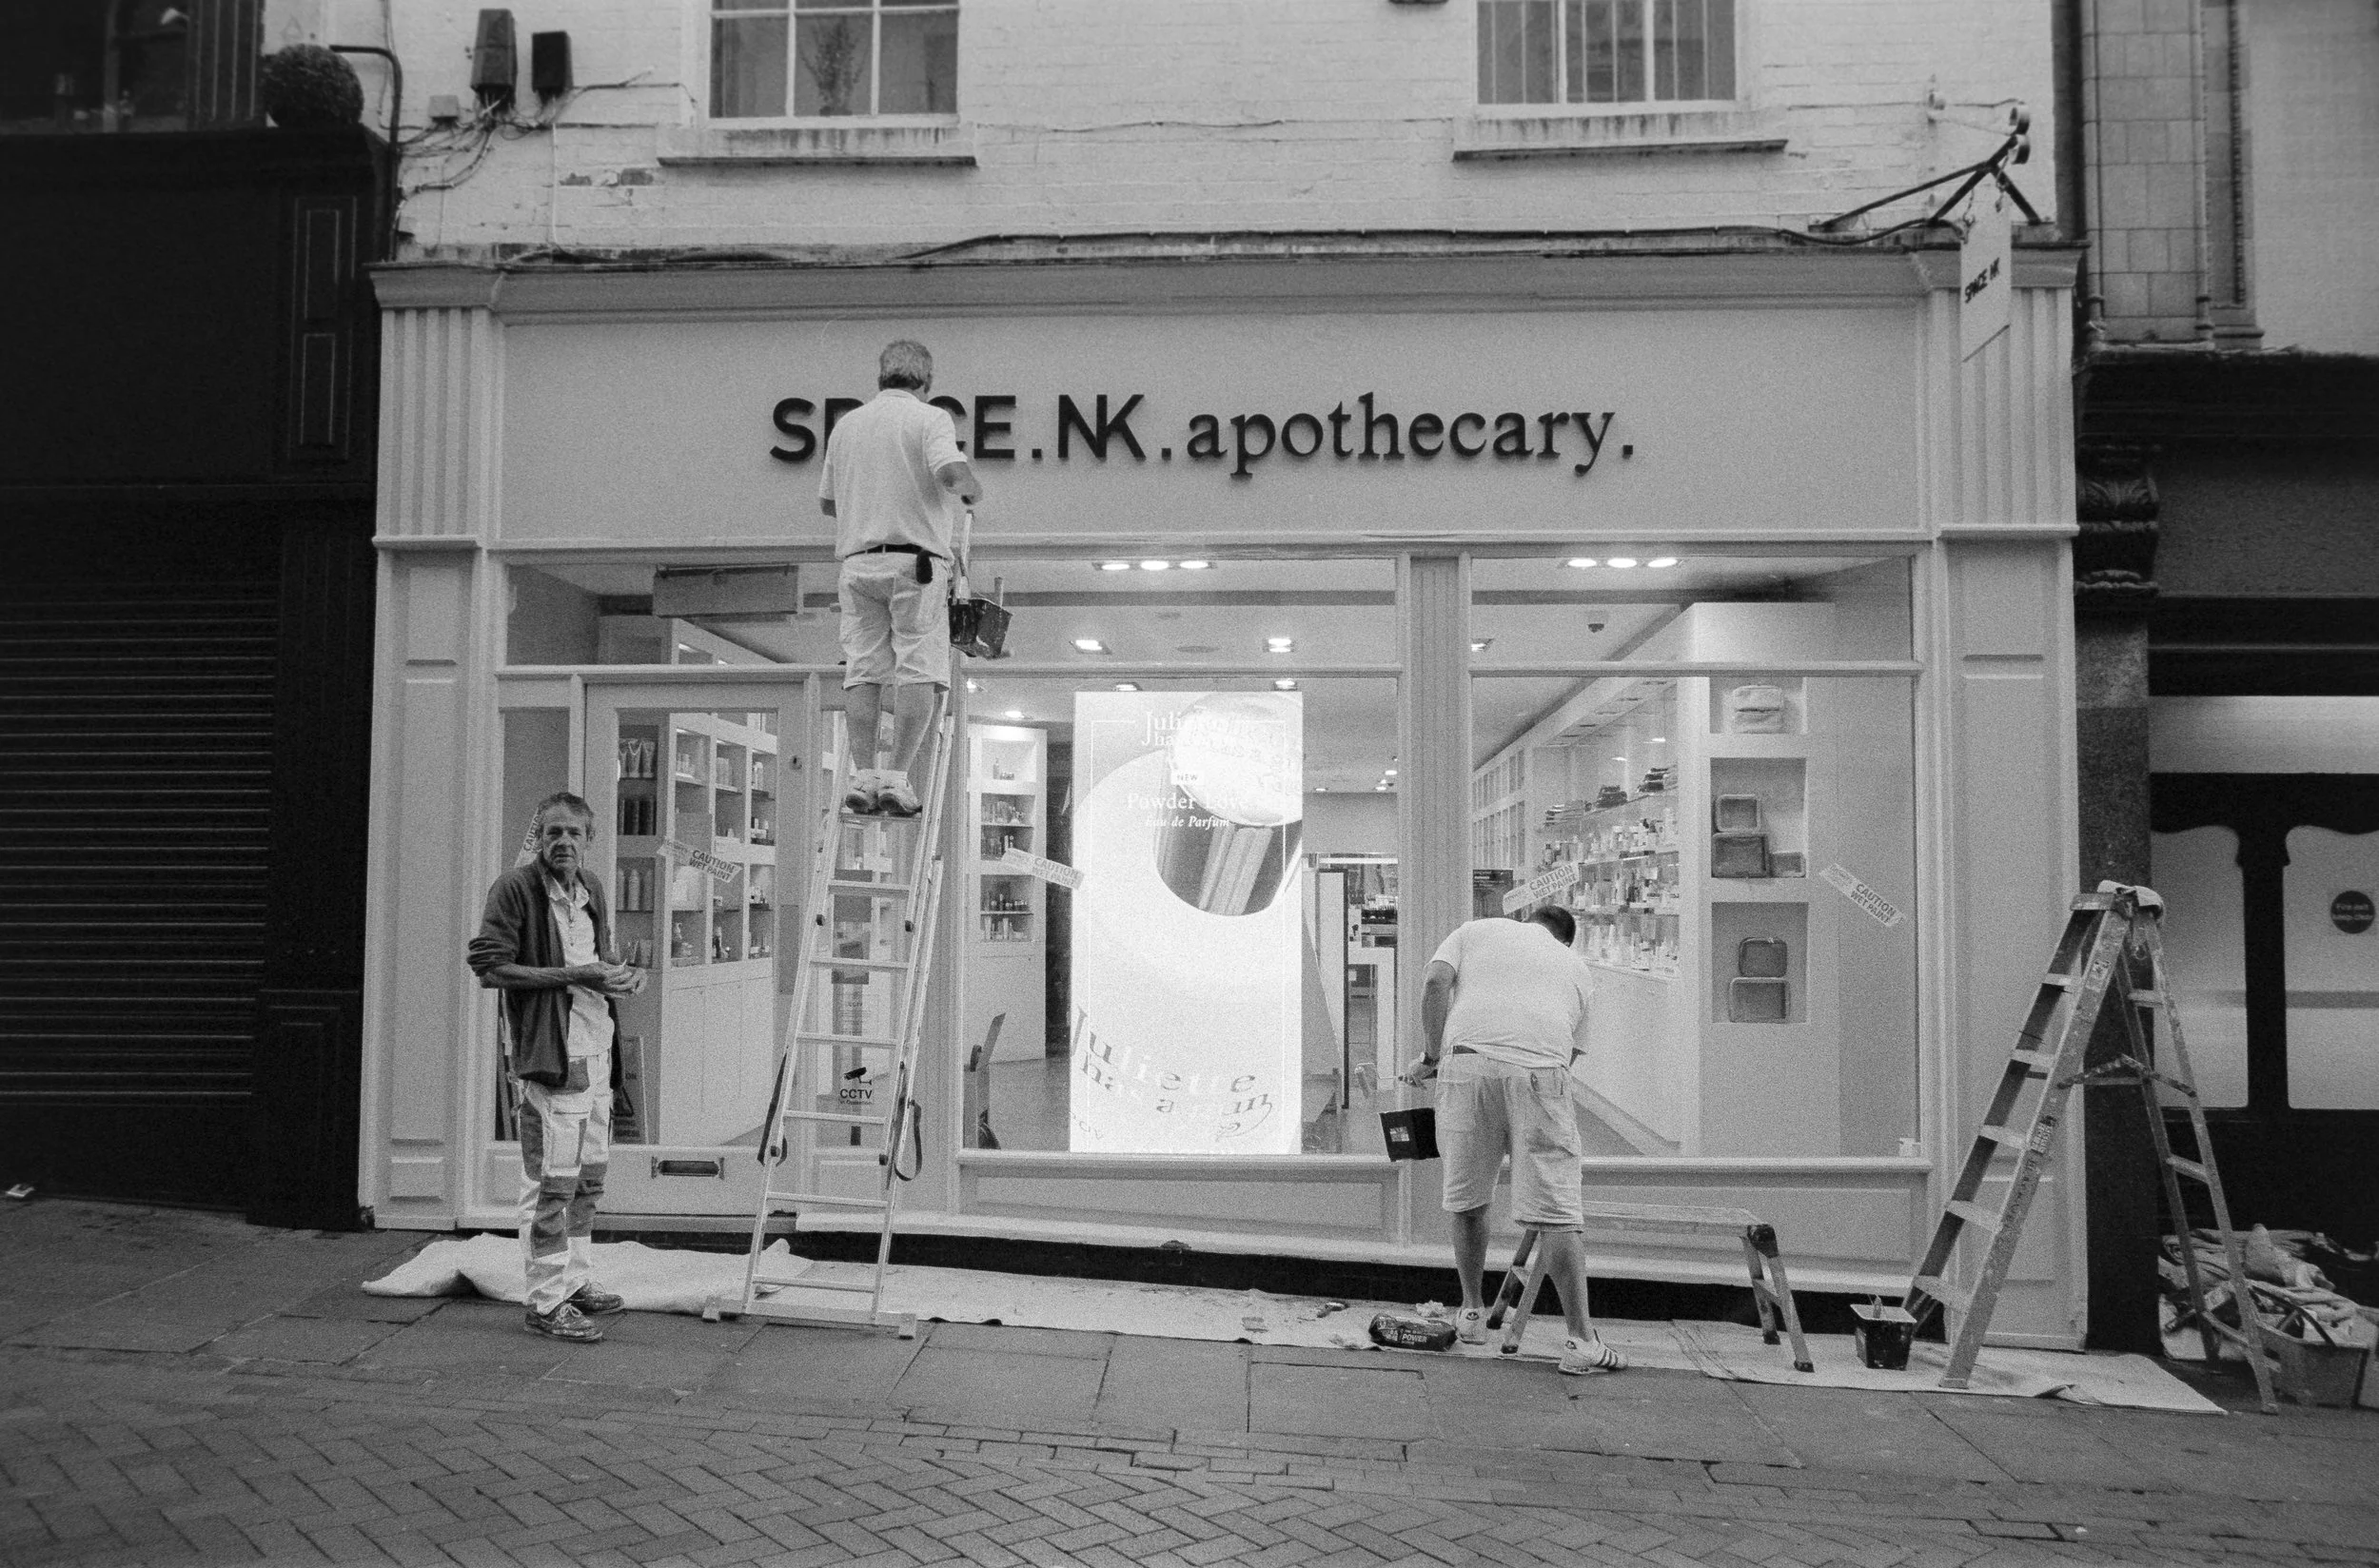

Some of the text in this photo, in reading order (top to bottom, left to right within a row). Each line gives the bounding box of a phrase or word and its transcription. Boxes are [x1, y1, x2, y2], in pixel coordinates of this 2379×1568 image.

[1127, 793, 1196, 810] Powder
[1170, 815, 1185, 828] de
[1188, 815, 1230, 831] Parfum
[689, 857, 732, 881] WET PAINT
[692, 850, 736, 873] CAUTION
[1529, 864, 1574, 891] CAUTION
[1533, 886, 1552, 899] WET
[1552, 874, 1577, 891] PAINT
[1850, 891, 1890, 924] WET PAINT
[1856, 883, 1897, 917] CAUTION
[839, 1088, 873, 1099] CCTV
[1402, 1333, 1427, 1343] POWER
